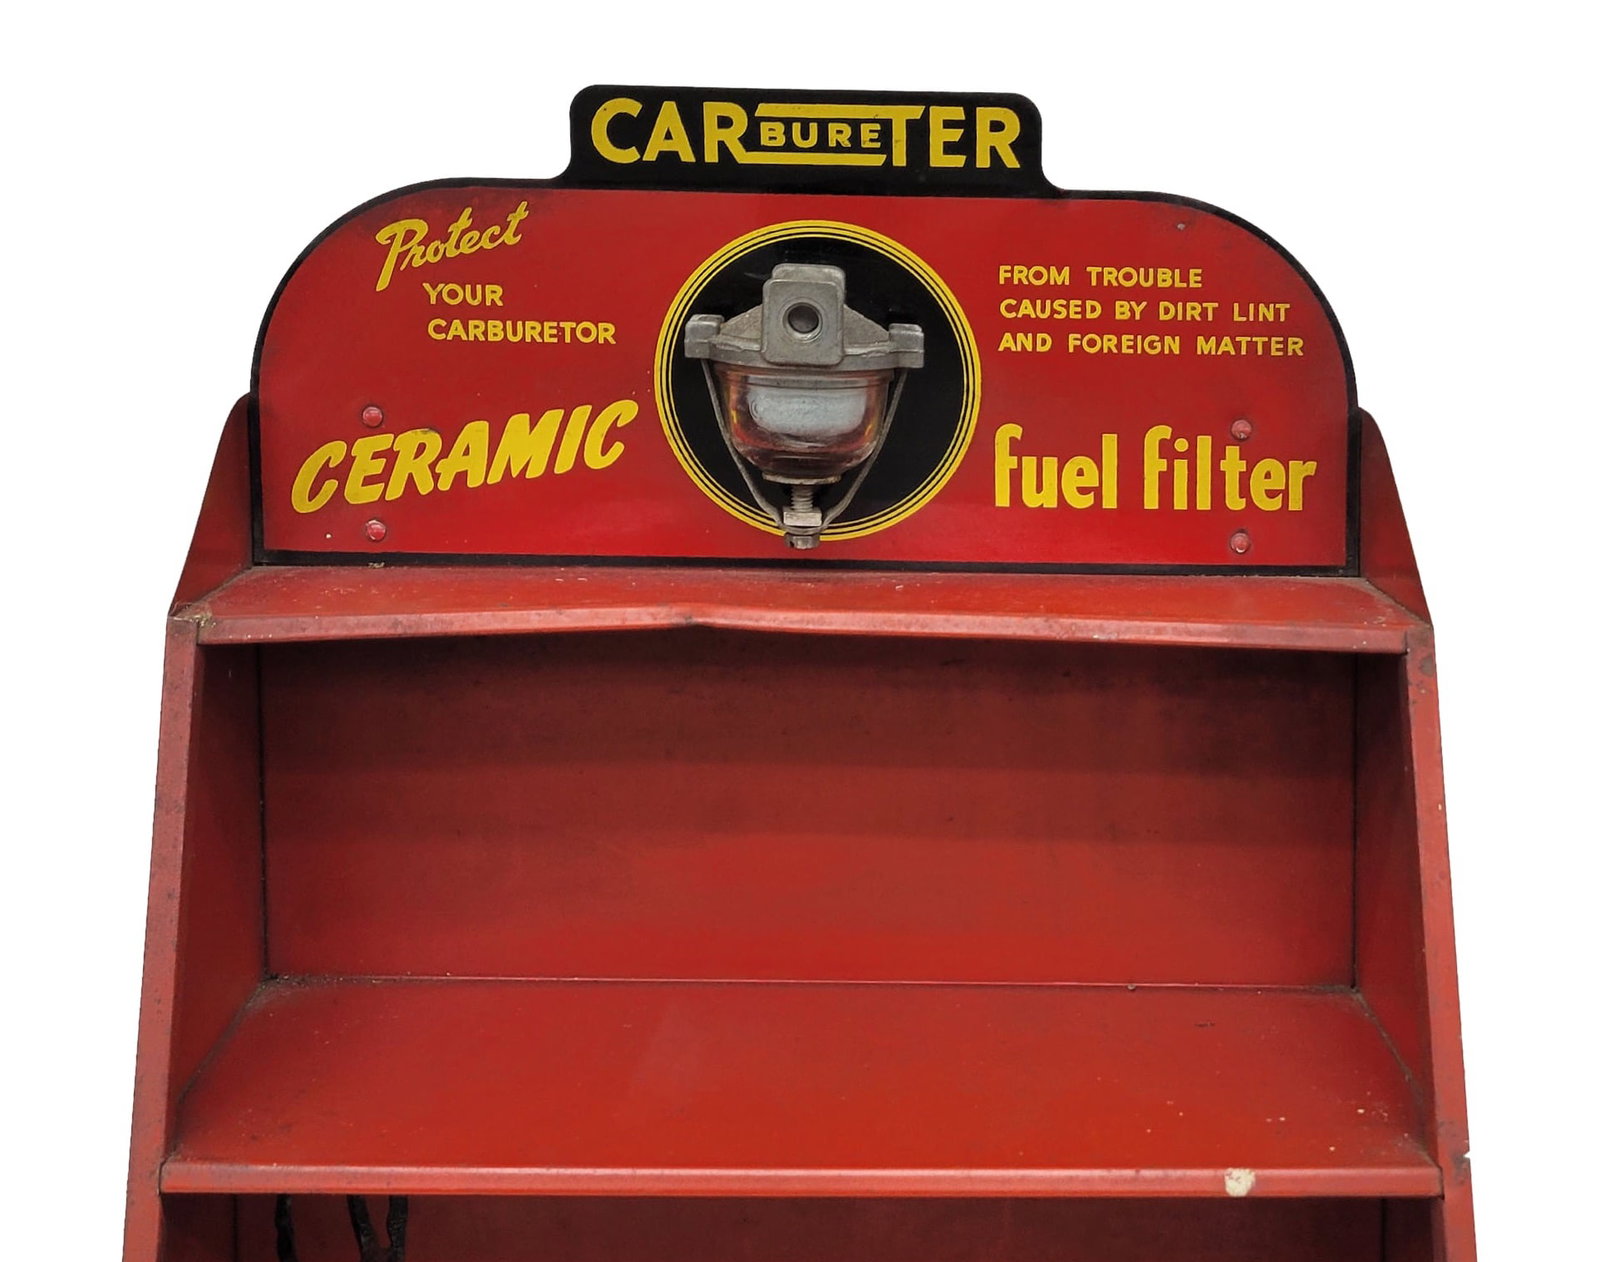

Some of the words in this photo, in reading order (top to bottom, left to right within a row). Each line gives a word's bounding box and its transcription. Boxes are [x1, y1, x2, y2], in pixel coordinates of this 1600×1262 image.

[590, 97, 1022, 170] CARBURETER
[376, 200, 529, 292] Protect
[998, 265, 1071, 287] FROM
[1086, 266, 1203, 289] TROUBLE
[422, 283, 504, 307] YOUR
[999, 299, 1103, 320] CAUSED
[1115, 301, 1147, 322] BY
[1158, 302, 1219, 323] DIRT
[1233, 303, 1291, 323] LINT
[427, 318, 616, 345] CARBURETOR
[998, 332, 1053, 353] AND
[1068, 334, 1181, 356] FOREIGN
[1196, 337, 1305, 357] MATTER
[291, 399, 640, 515] CERAMIC
[994, 422, 1119, 510] fuel
[1143, 424, 1318, 512] filter
